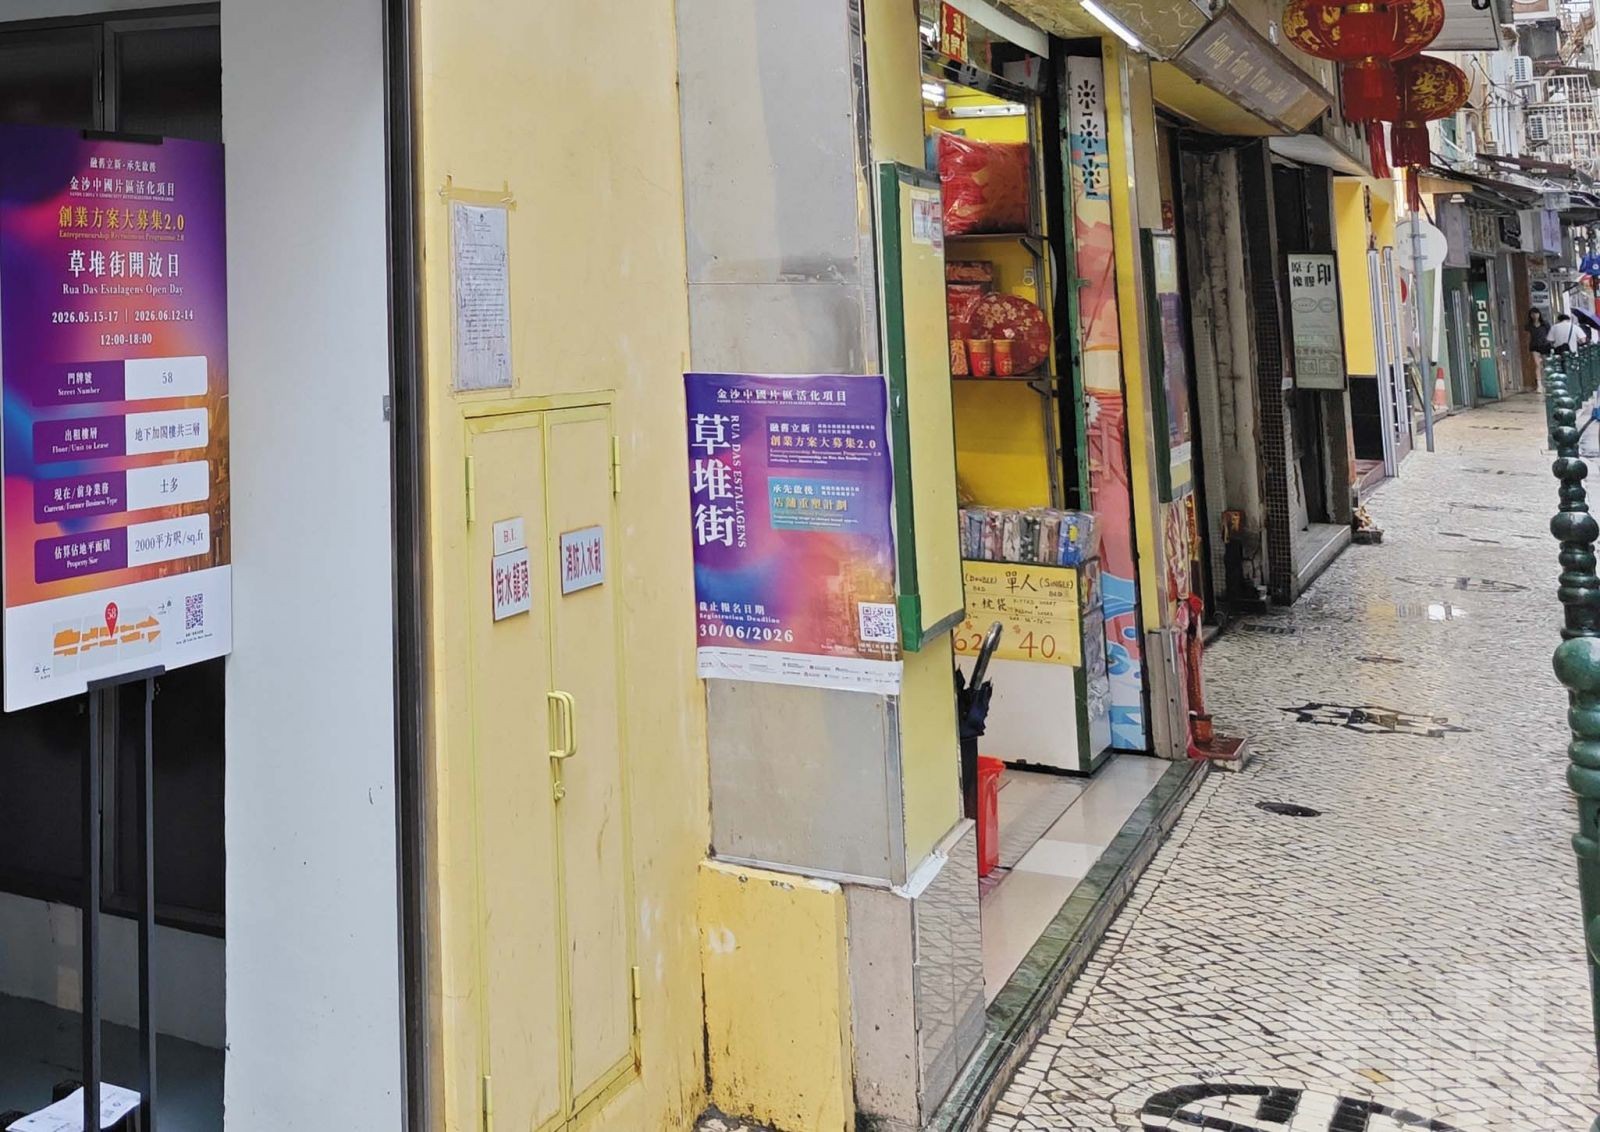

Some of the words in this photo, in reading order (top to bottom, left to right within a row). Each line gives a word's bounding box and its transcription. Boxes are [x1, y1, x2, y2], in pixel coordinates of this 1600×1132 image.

[69, 175, 176, 197] 金沙中國片區活化項目
[59, 205, 185, 231] 創業方案大募集2.0
[67, 249, 180, 278] 草堆街開放日
[1316, 263, 1332, 287] 印
[62, 283, 80, 295] Rua
[82, 283, 98, 295] Das
[100, 283, 144, 296] Estalagens
[145, 284, 167, 296] Open
[169, 284, 184, 297] Day
[52, 311, 118, 324] 2026.05.15-17
[134, 308, 194, 322] 2026.06.12-14
[1475, 299, 1492, 359] POLICE
[100, 333, 153, 346] 12:00-18:00
[67, 372, 93, 385] 門牌號
[162, 372, 173, 384] 58
[57, 388, 76, 396] Street
[77, 387, 101, 395] Number
[730, 414, 741, 440] RUA
[731, 444, 742, 467] DAS
[160, 478, 179, 493] 士多
[690, 413, 736, 547] 草堆街
[106, 496, 118, 506] Type
[733, 470, 747, 548] ESTALAGENS
[1005, 571, 1038, 594] 單人
[107, 608, 117, 620] 58
[746, 615, 780, 624] Deadline
[699, 624, 794, 643] 30/06/2026
